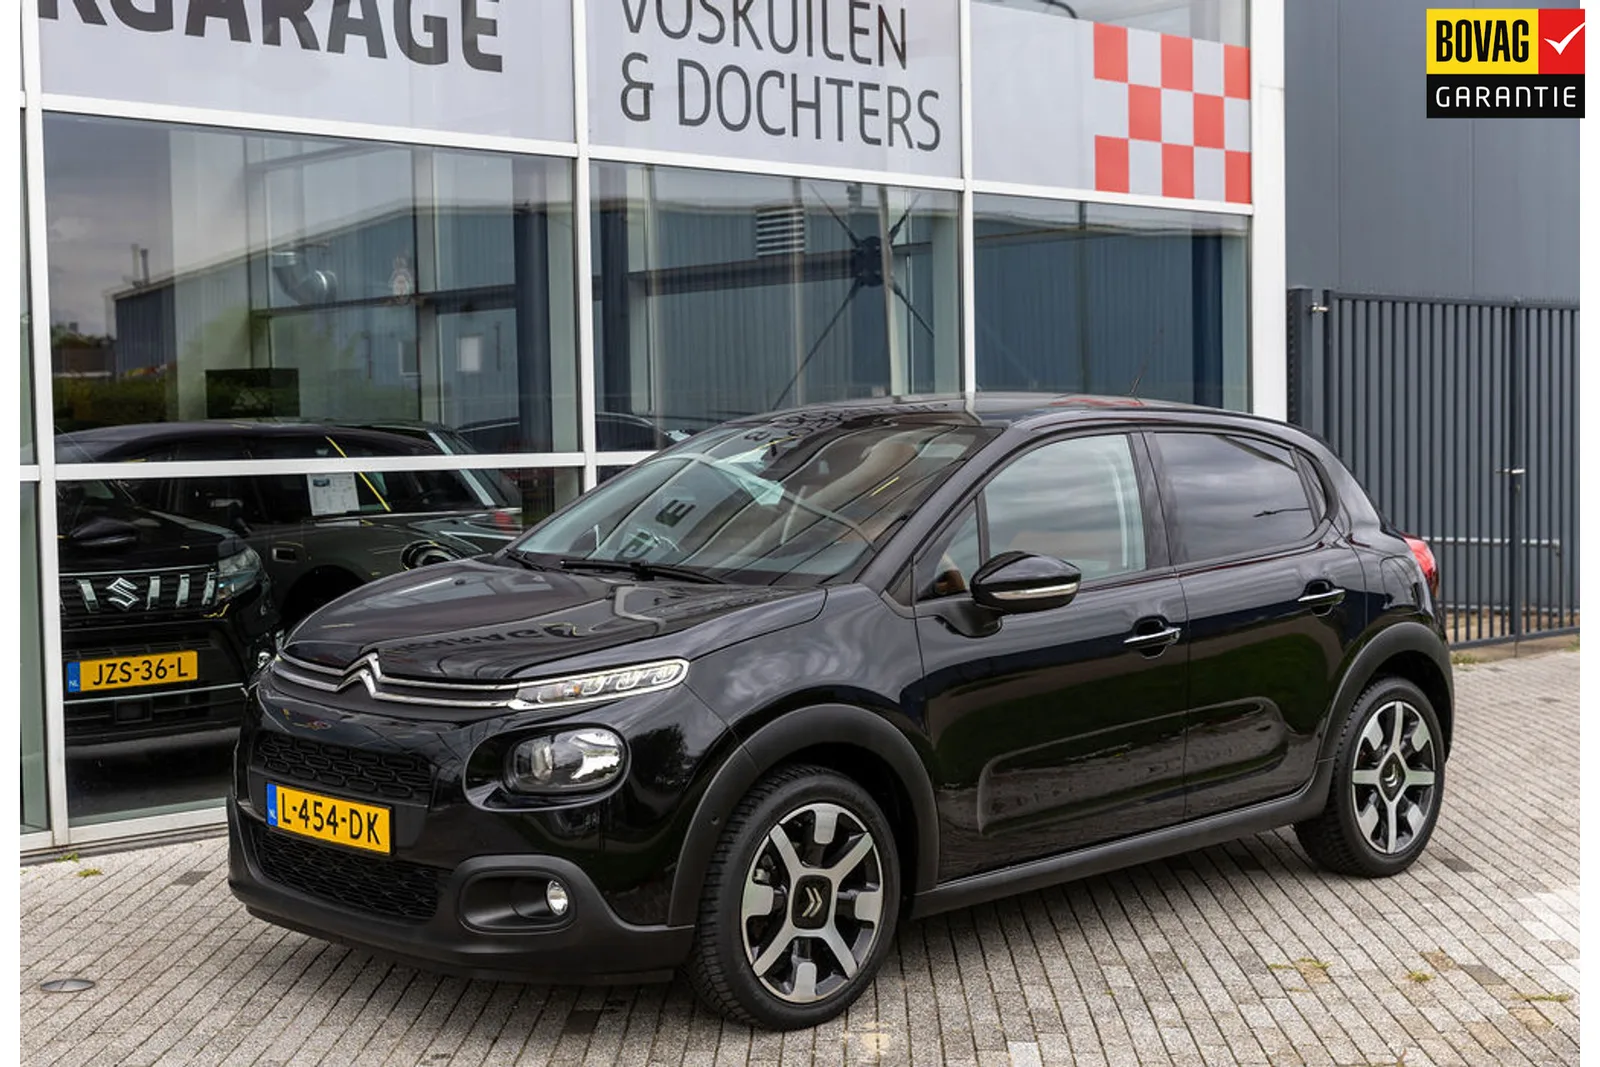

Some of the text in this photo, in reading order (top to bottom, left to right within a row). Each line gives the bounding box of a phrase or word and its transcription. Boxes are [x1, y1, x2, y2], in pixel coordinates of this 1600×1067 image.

[38, 0, 503, 73] ARAGE
[620, 52, 940, 151] & DOCHTERS
[93, 657, 188, 686] JZS-36-L
[281, 793, 380, 845] L-454-DK
